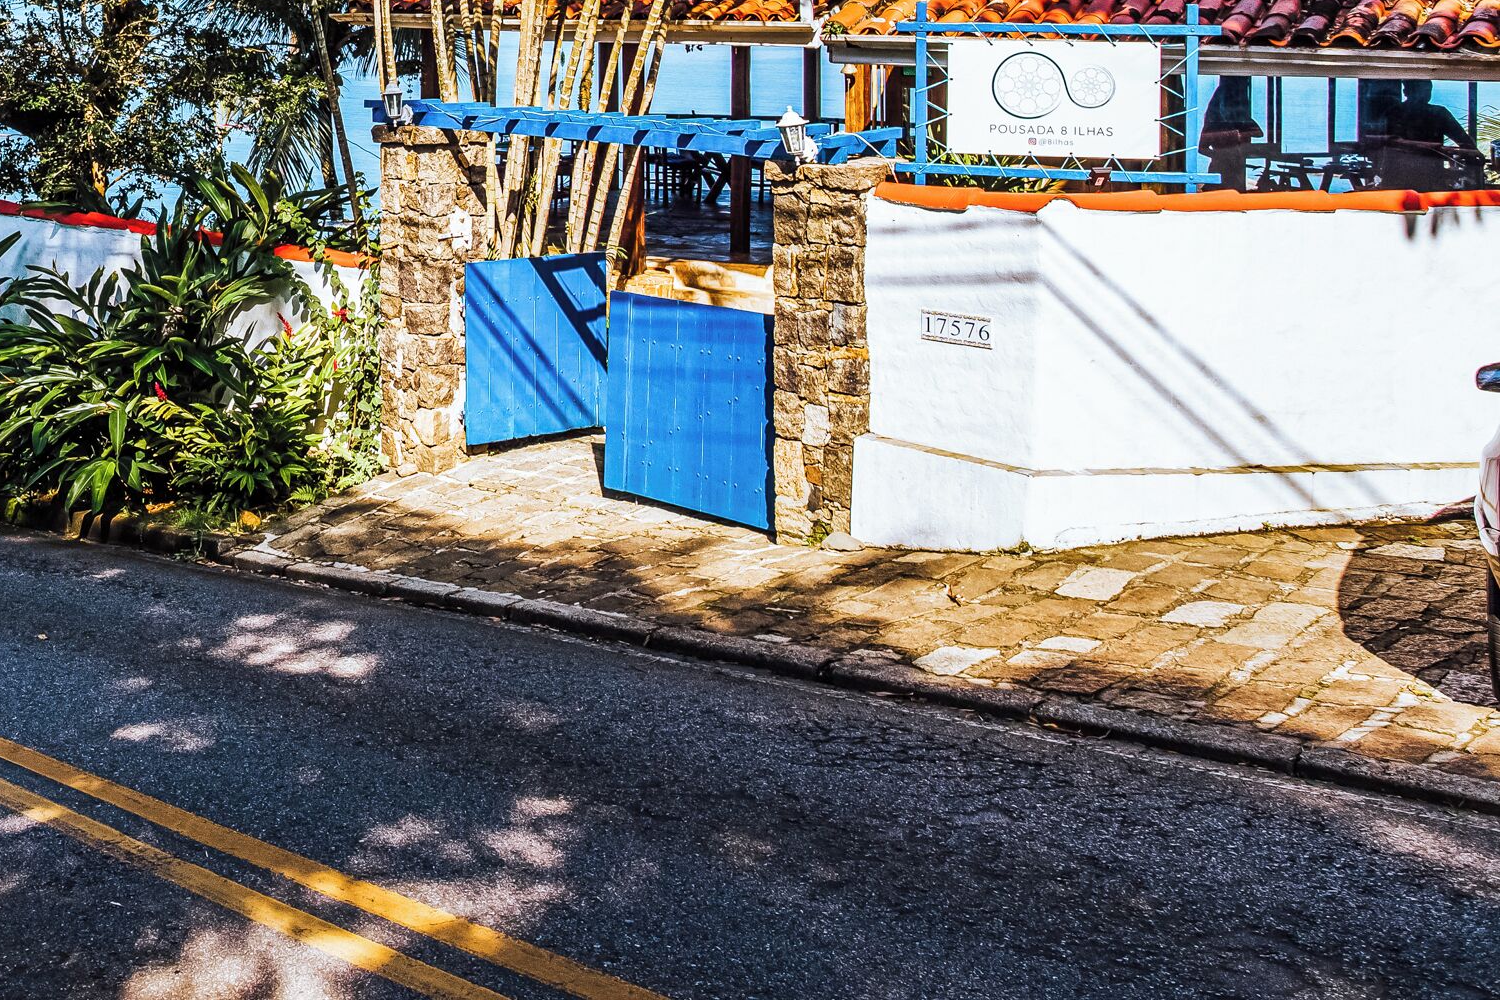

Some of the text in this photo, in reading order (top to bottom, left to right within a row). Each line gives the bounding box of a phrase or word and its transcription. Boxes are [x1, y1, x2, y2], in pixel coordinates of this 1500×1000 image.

[989, 124, 1114, 137] POUSADA 8 ILHAS
[924, 316, 991, 341] 17576
